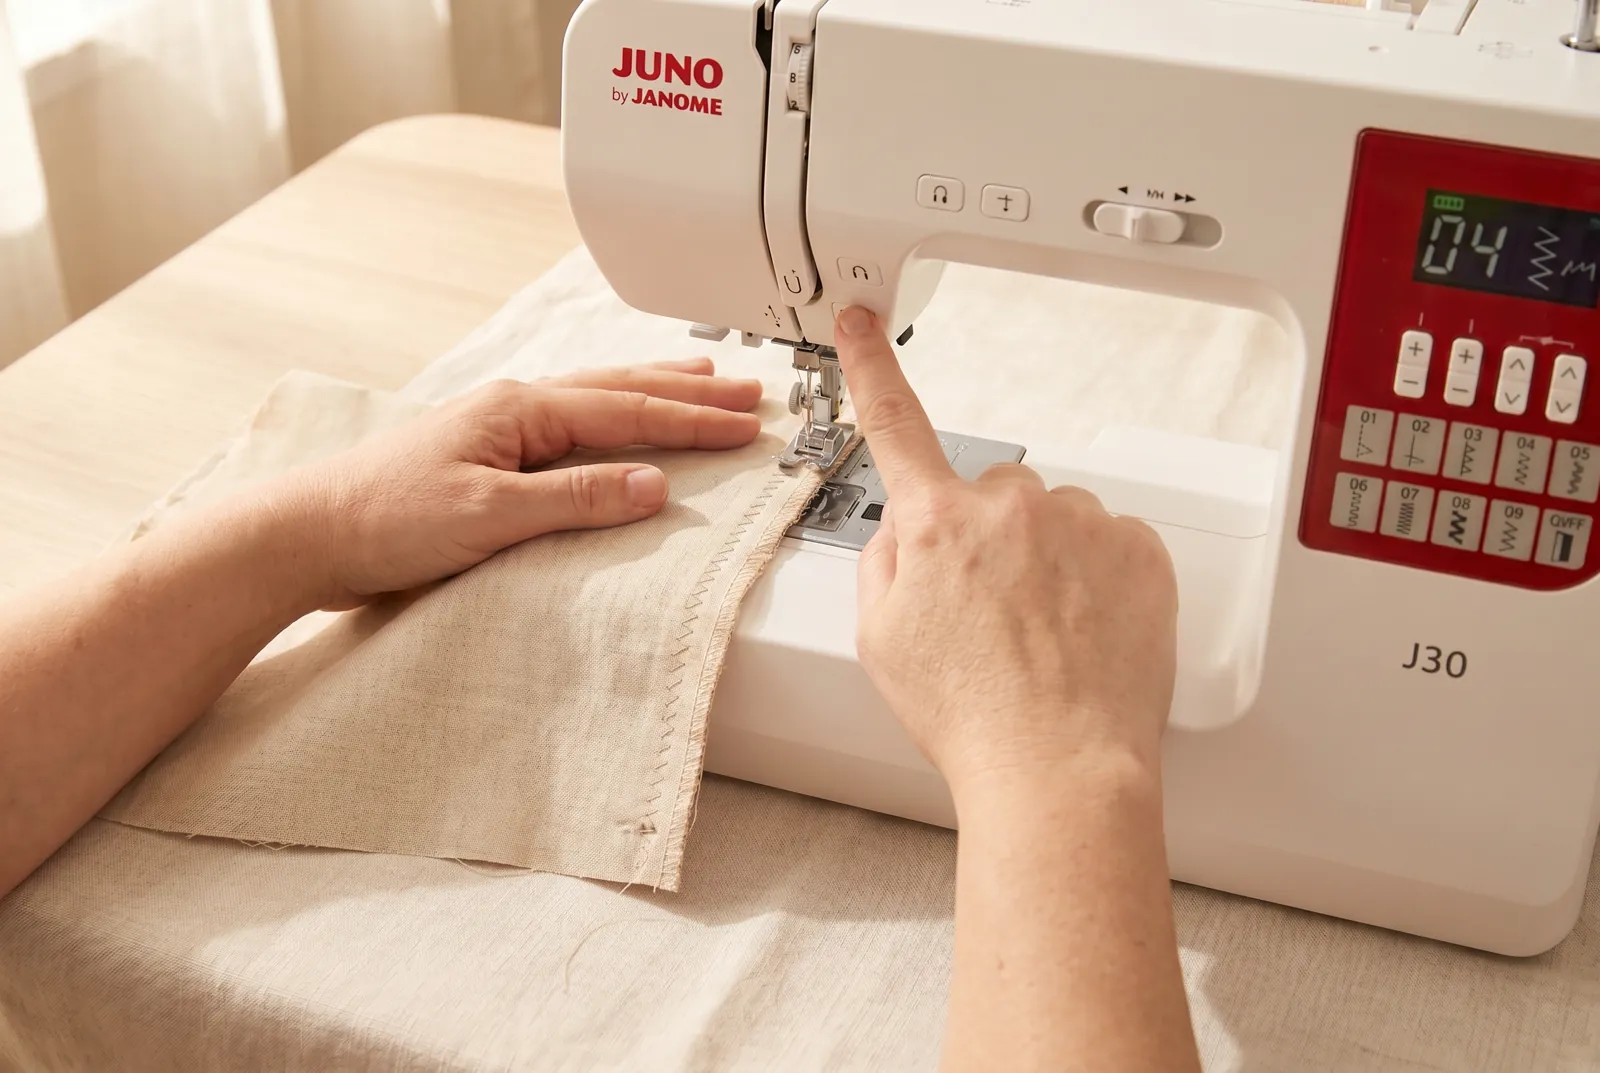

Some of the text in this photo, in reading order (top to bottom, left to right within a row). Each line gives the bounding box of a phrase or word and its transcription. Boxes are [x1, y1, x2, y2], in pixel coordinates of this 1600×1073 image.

[611, 47, 723, 89] JUNO
[612, 87, 722, 116] by JANOME
[1422, 214, 1508, 278] 04
[1360, 410, 1377, 425] 01
[1411, 419, 1431, 434] 02
[1464, 427, 1483, 442] 03
[1516, 436, 1536, 451] 04
[1570, 445, 1591, 461] 05
[1349, 477, 1368, 492] 06
[1400, 486, 1420, 501] 07
[1452, 496, 1471, 511] 08
[1504, 505, 1524, 520] 09
[1402, 642, 1468, 679] J30
